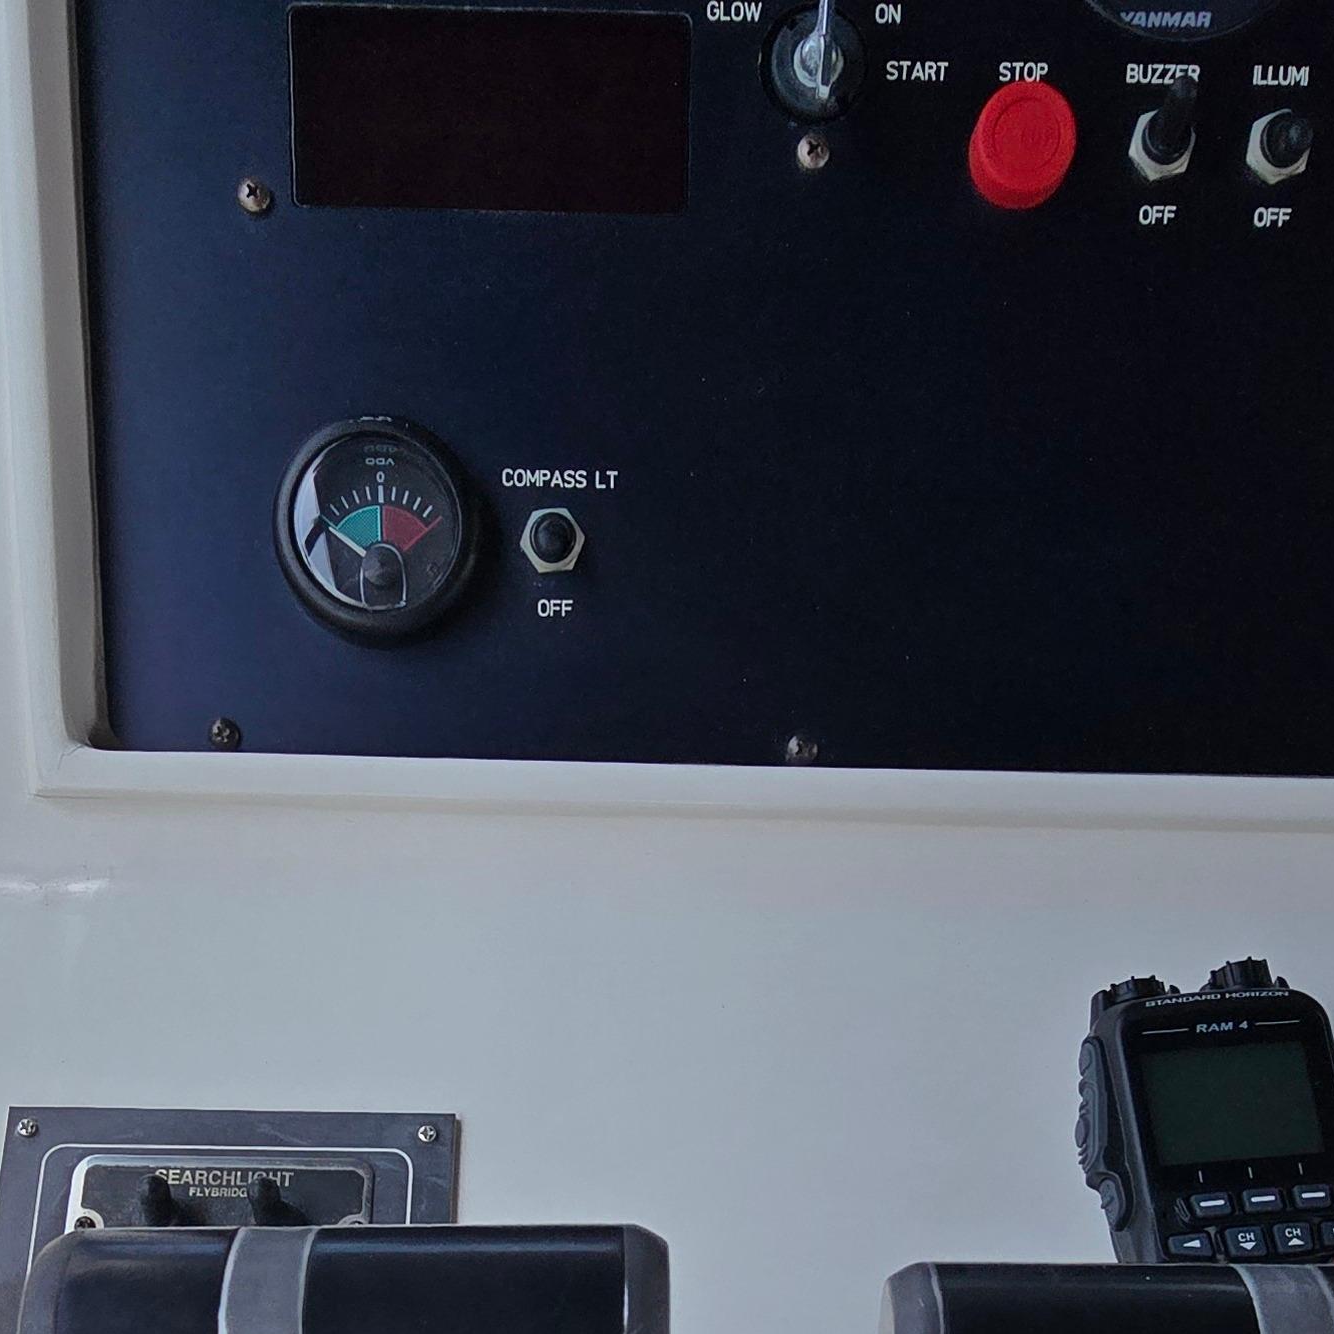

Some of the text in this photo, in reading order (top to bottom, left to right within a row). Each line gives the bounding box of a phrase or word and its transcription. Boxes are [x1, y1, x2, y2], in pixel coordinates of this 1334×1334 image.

[706, 0, 762, 22] GLOW
[875, 3, 902, 24] ON
[1120, 11, 1212, 28] YANMAR
[885, 61, 949, 82] START
[998, 61, 1049, 82] STOP
[1125, 63, 1201, 84] BUZZER
[1252, 65, 1310, 86] ILLUMI
[1138, 204, 1177, 225] OFF
[1253, 206, 1293, 228] OFF
[501, 468, 619, 489] COMPASS LT
[537, 598, 574, 618] OFF
[1145, 990, 1289, 1008] STANDARD HORIZON
[1195, 1020, 1248, 1033] RAM 4
[188, 1186, 248, 1198] FLYBRIDG
[1237, 1231, 1255, 1243] CH
[1284, 1227, 1302, 1238] CH
